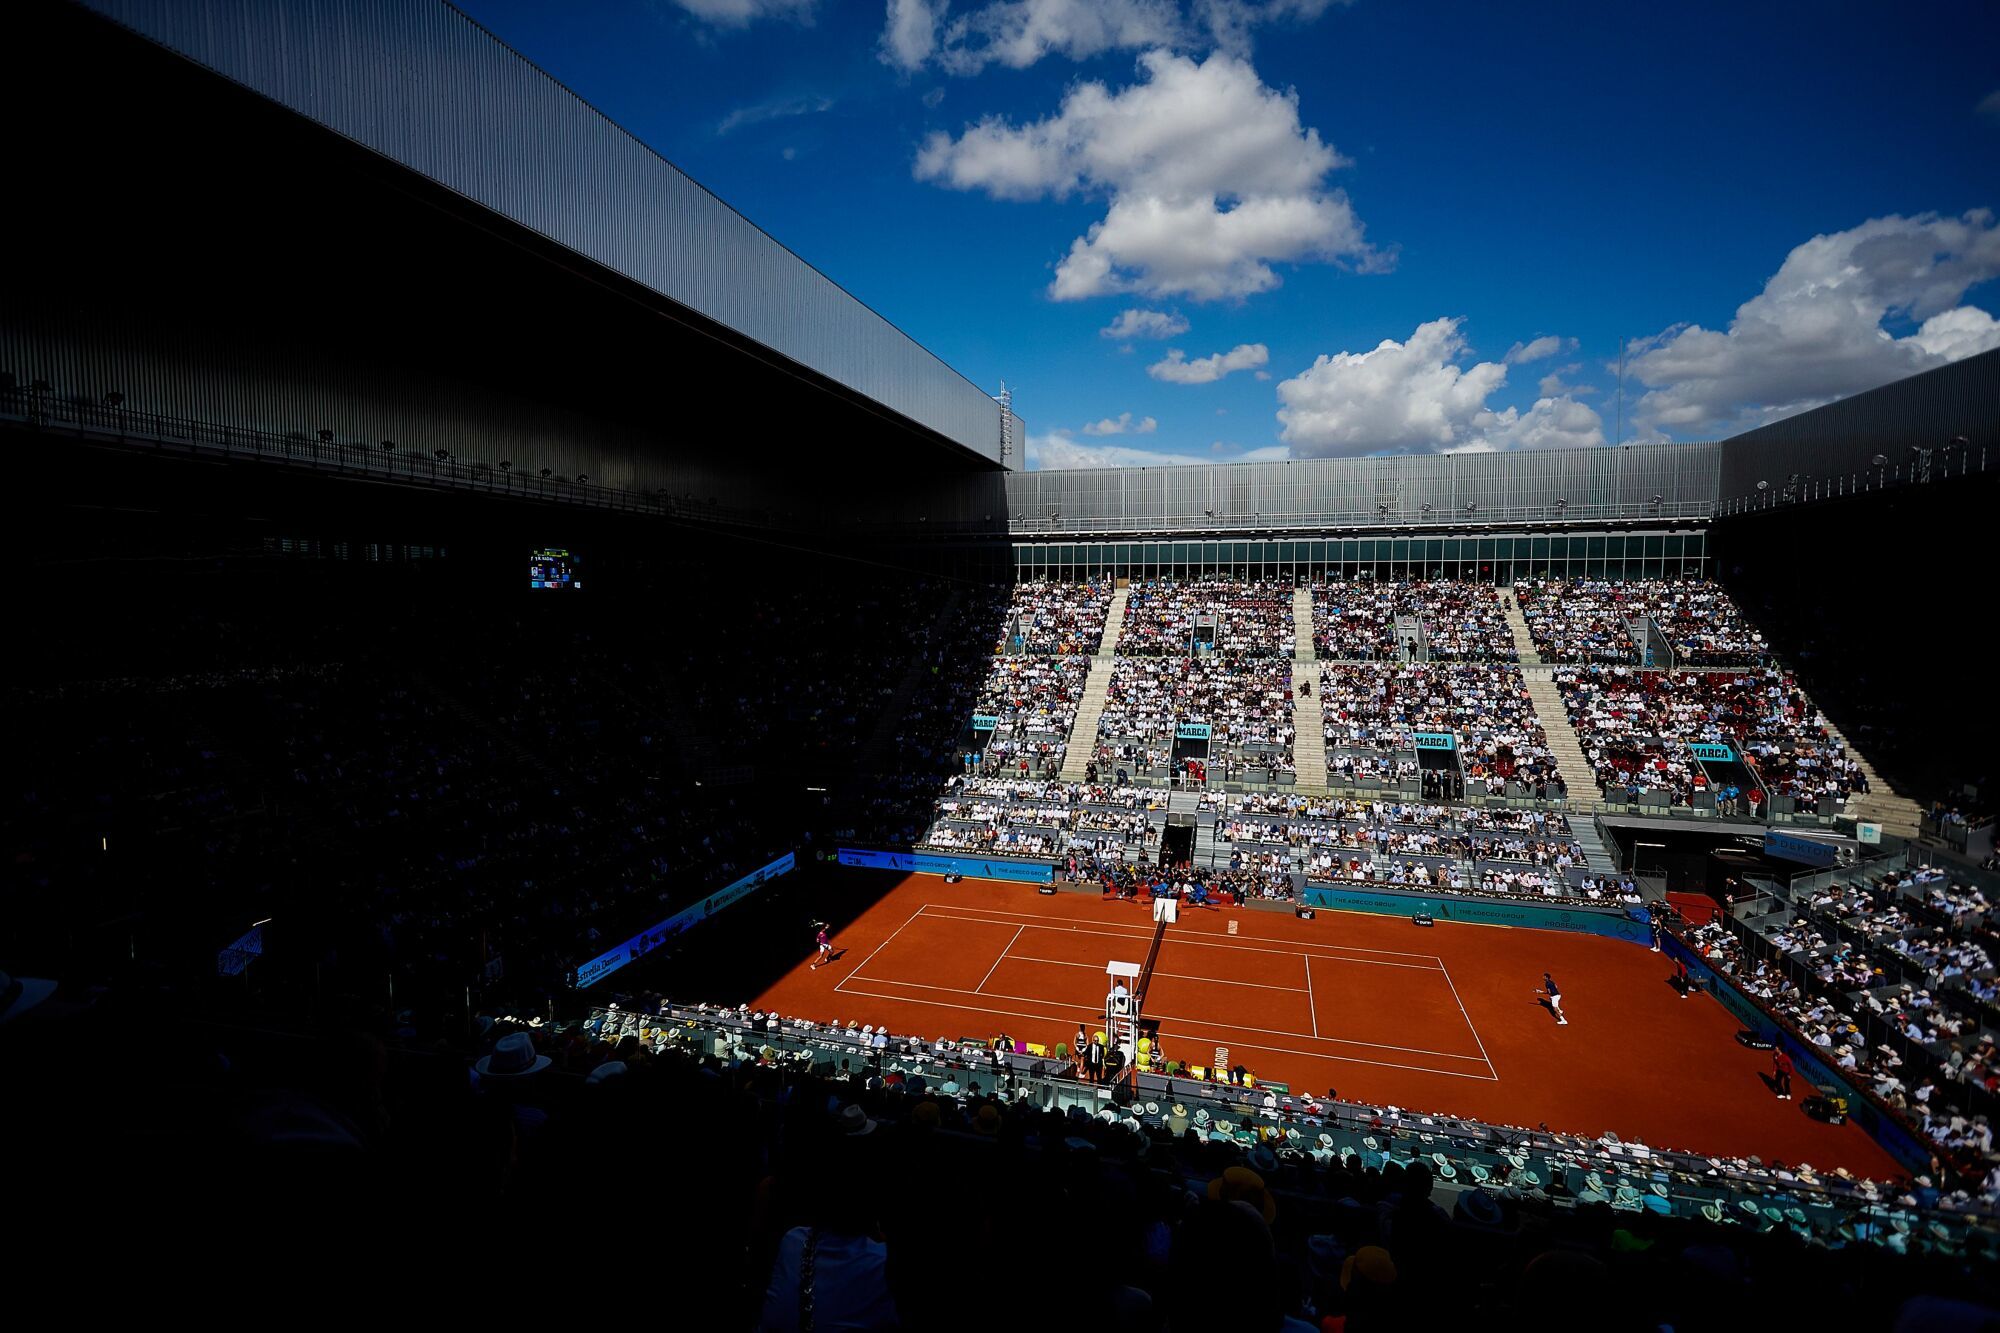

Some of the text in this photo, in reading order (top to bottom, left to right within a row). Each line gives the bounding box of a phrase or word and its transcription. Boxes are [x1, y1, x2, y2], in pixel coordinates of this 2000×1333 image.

[973, 719, 996, 728] MARCA
[1179, 727, 1207, 736] MARCA
[1415, 736, 1448, 747] MARCA
[1780, 840, 1832, 858] DEKTON
[1473, 910, 1500, 918] ADECCO
[1544, 920, 1587, 930] PROSEGUR
[577, 961, 601, 981] strella
